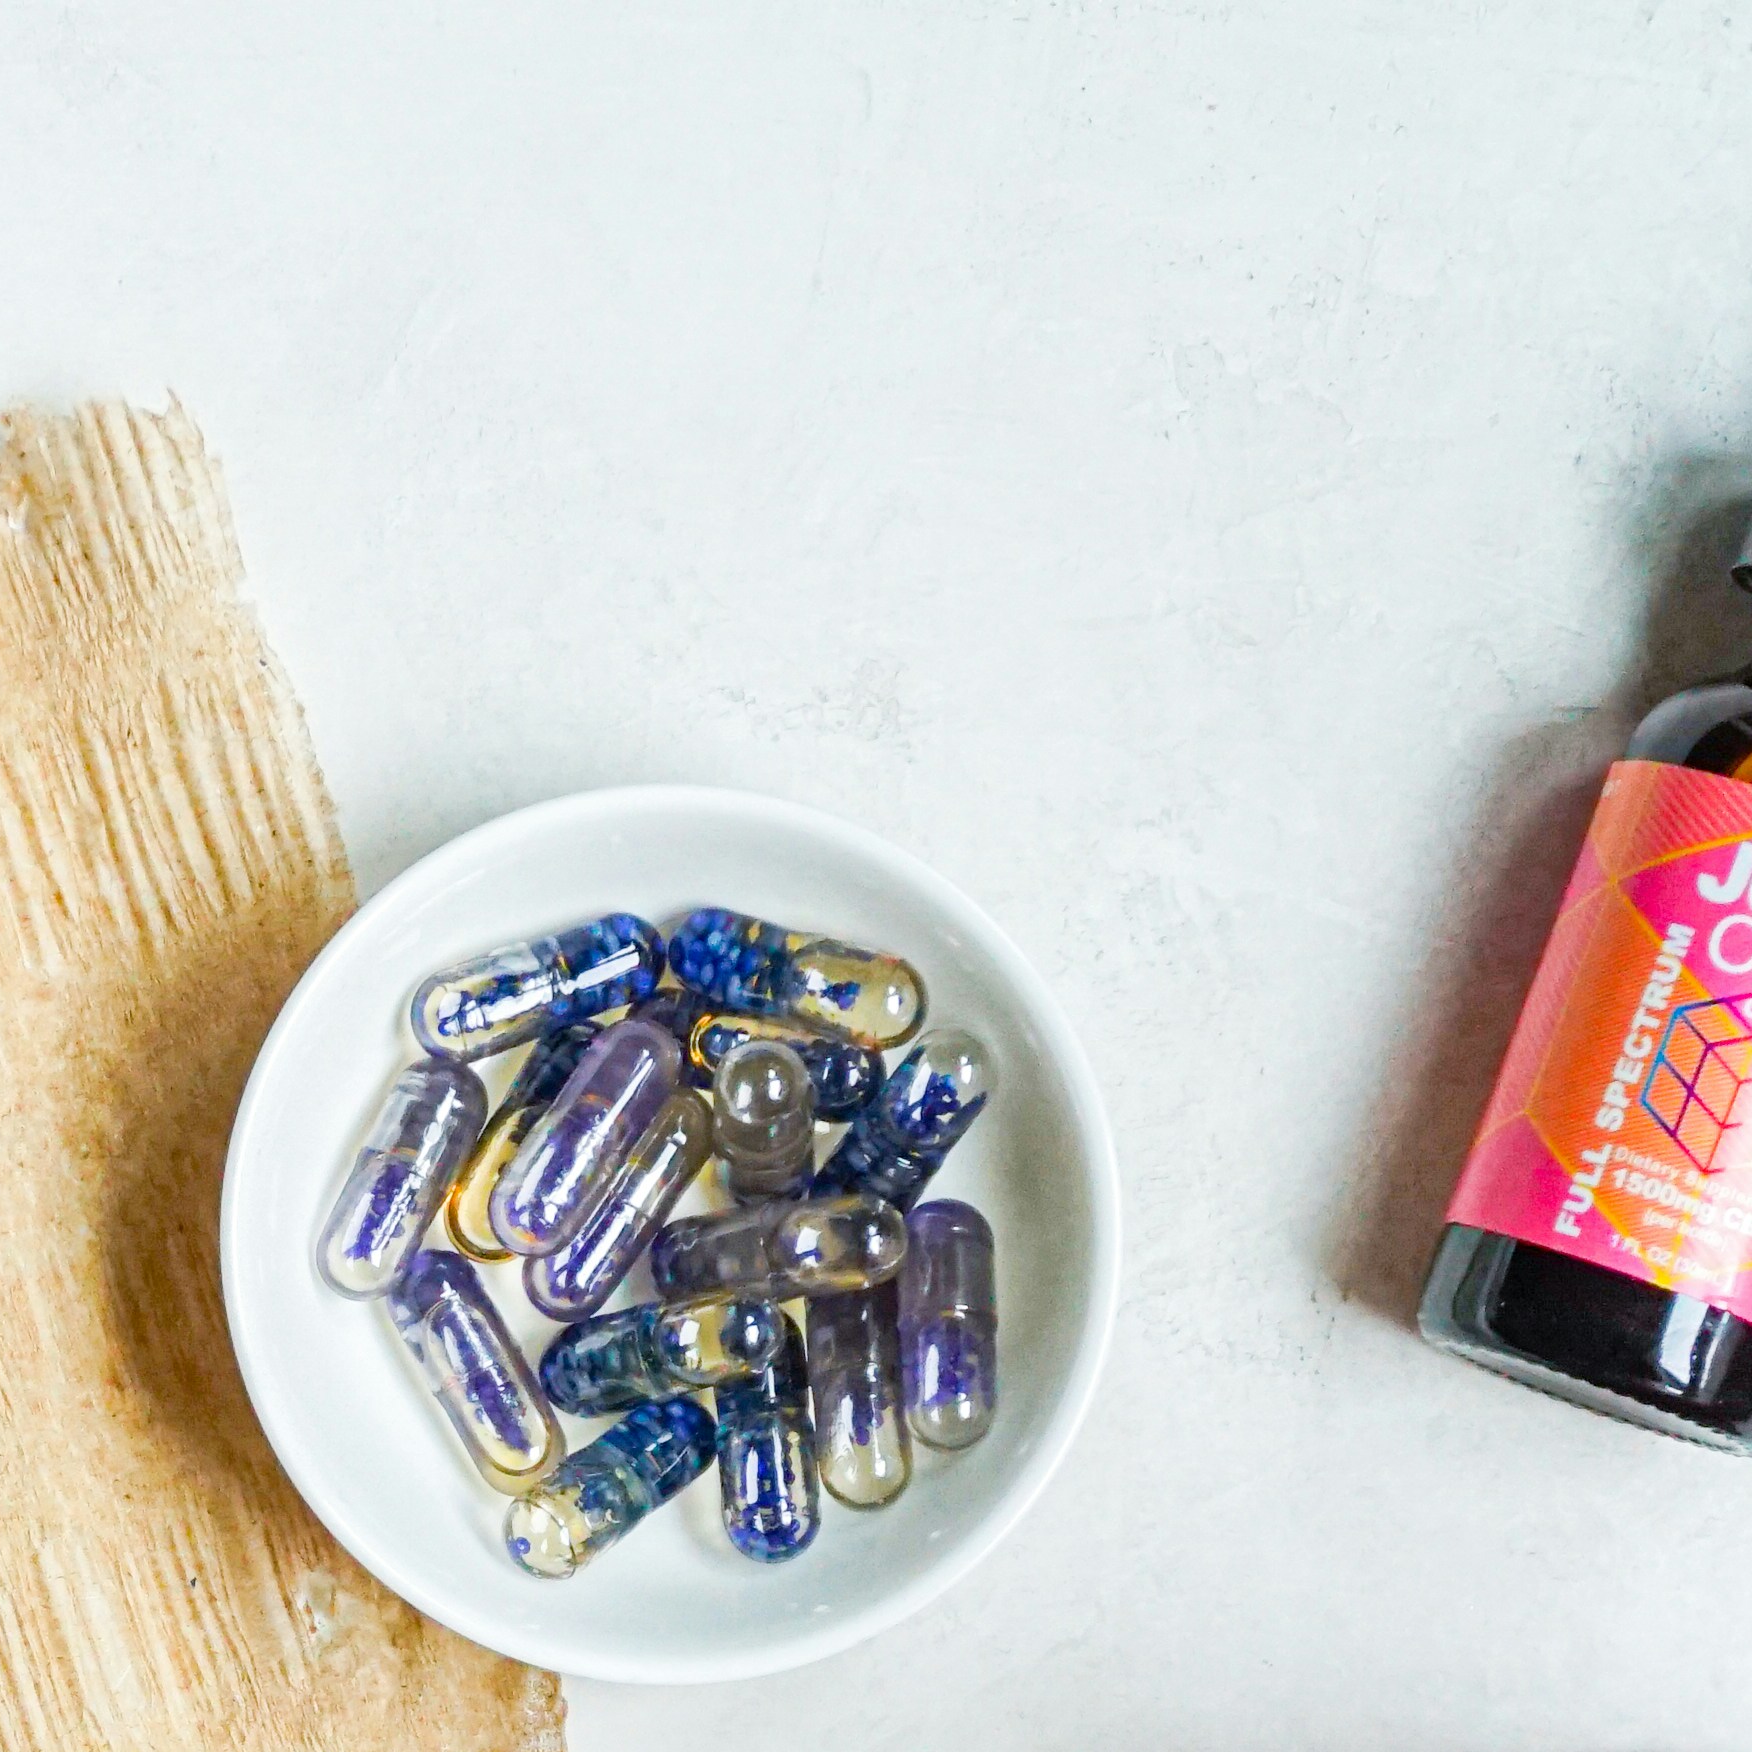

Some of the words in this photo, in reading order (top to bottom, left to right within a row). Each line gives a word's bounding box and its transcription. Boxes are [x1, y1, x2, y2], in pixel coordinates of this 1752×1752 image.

[1553, 1143, 1613, 1238] FULL
[1595, 921, 1696, 1132] SPECTRUM
[1613, 1146, 1680, 1180] Dietary
[1612, 1166, 1718, 1226] 1500mg
